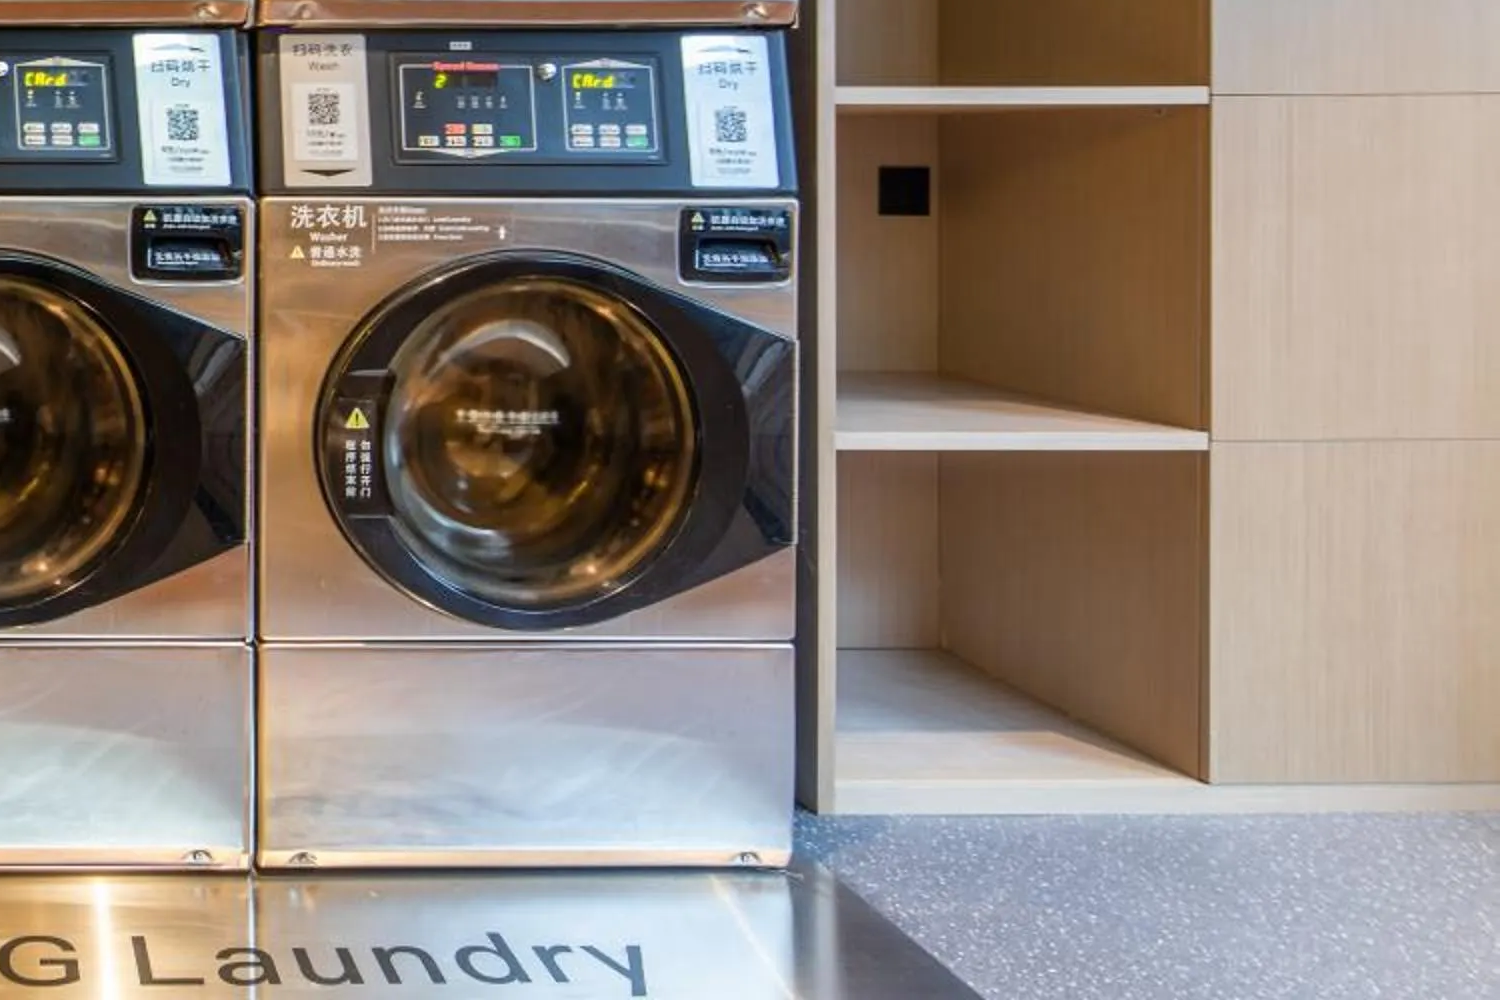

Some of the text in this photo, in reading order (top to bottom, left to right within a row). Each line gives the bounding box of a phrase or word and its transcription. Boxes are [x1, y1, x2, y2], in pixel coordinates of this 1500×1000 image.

[171, 77, 190, 88] Dry
[719, 79, 739, 90] Dry
[291, 204, 367, 228] 洗衣机
[309, 231, 348, 242] Washer
[310, 245, 362, 258] 普通水洗
[130, 931, 649, 997] Laundry
